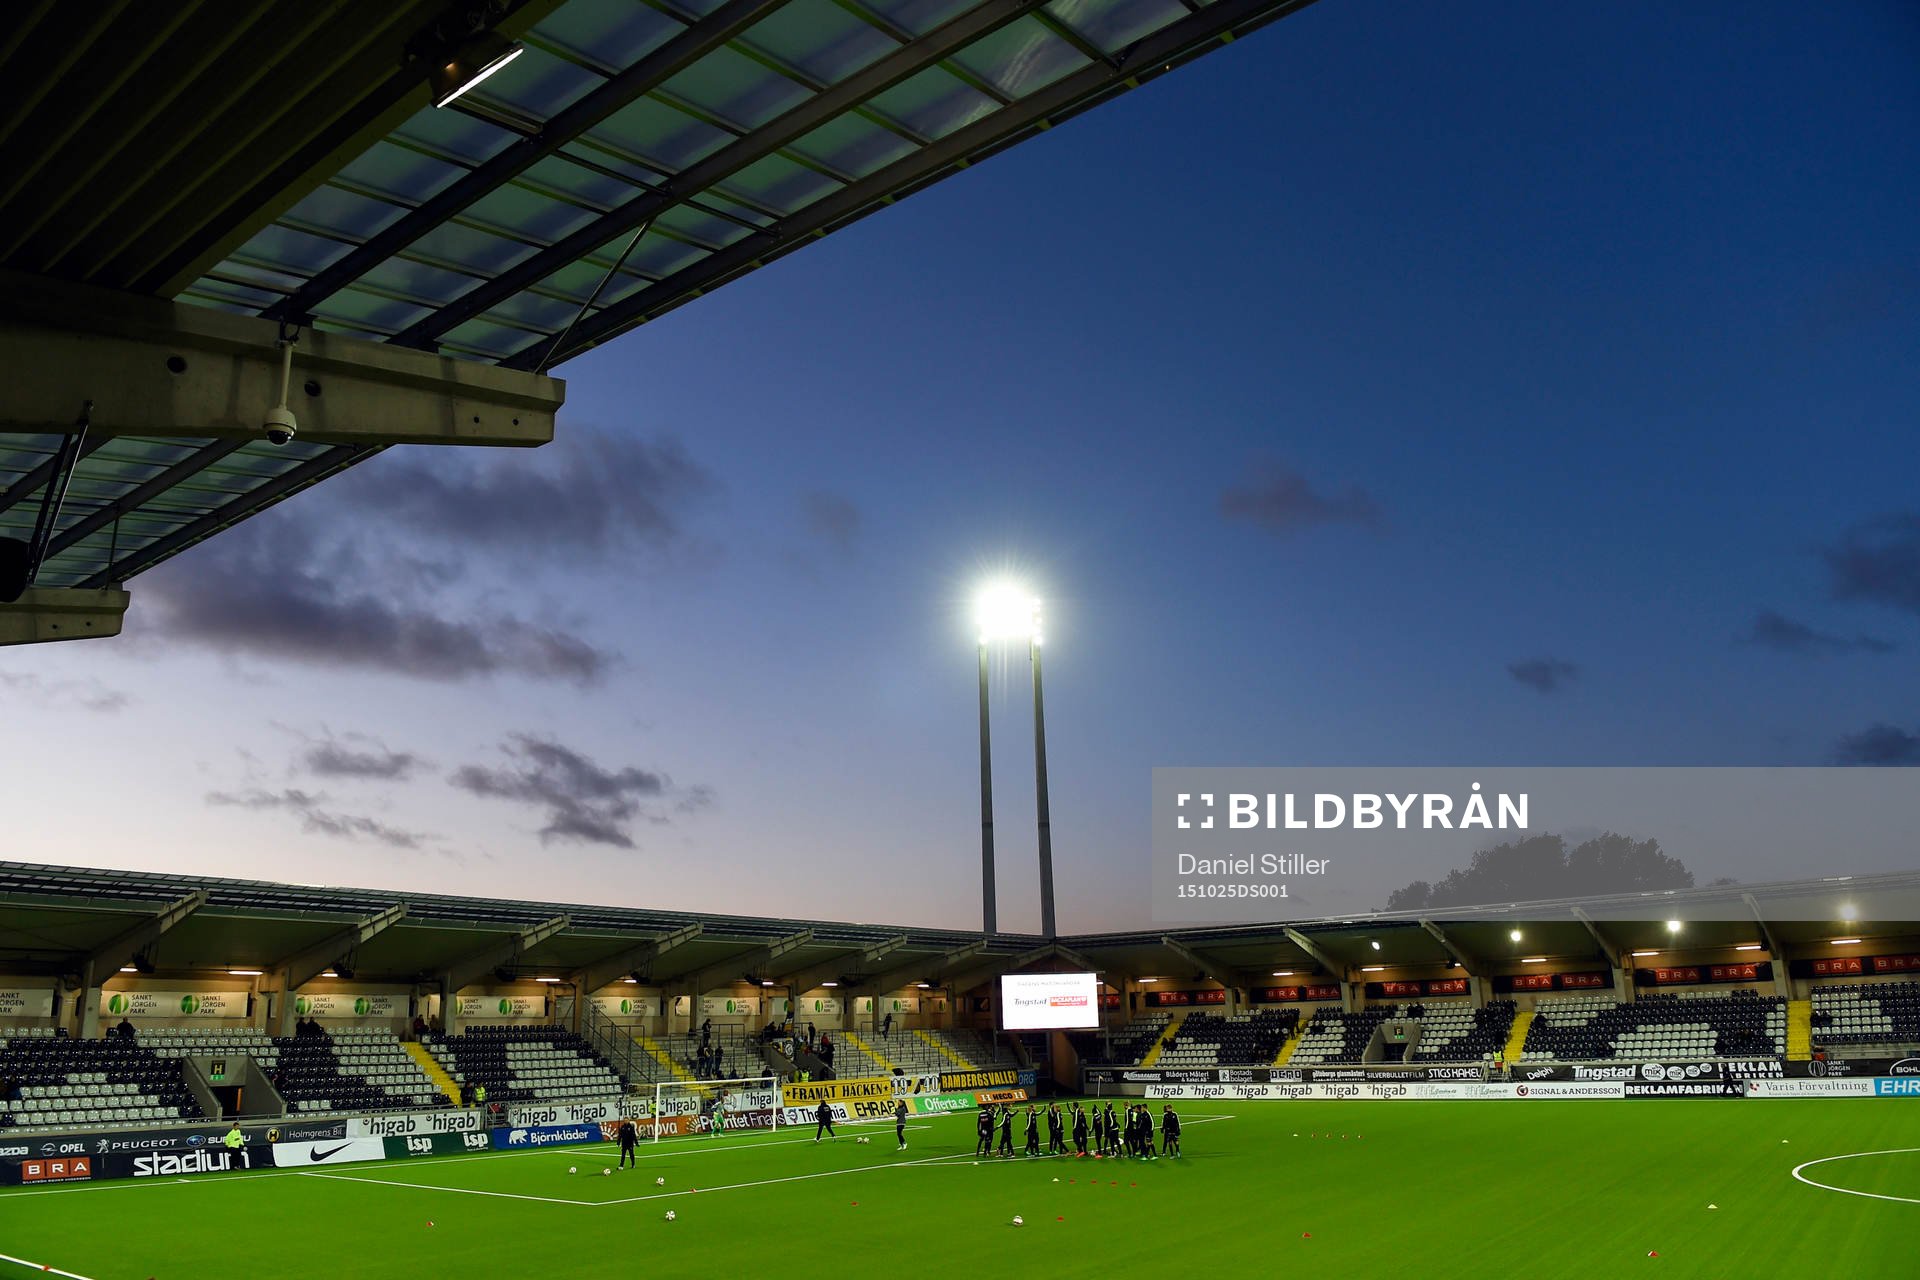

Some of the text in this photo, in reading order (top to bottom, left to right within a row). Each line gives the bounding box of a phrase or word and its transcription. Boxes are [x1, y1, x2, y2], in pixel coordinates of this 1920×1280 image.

[1817, 960, 1859, 971] BRA
[1878, 957, 1920, 967] BRA
[1660, 971, 1697, 979] BRA
[1714, 968, 1753, 976] BRA
[1515, 978, 1550, 986] BRA
[1565, 976, 1600, 984] BRA
[1309, 987, 1338, 996] BRA
[1386, 985, 1419, 993] BRA
[1432, 983, 1463, 991] BRA
[213, 1064, 223, 1074] H
[1526, 1066, 1554, 1080] Delphi
[1572, 1065, 1637, 1080] Tingstad
[1644, 1067, 1661, 1076] mix
[941, 1070, 1018, 1089] RAMBERGSVALLEN
[1230, 1075, 1253, 1083] bolaget
[843, 1083, 883, 1098] HÄCKEN
[892, 1078, 908, 1095] 19
[1154, 1085, 1183, 1098] higab
[1195, 1085, 1225, 1098] higab
[1236, 1085, 1268, 1098] higab
[1280, 1085, 1312, 1098] higab
[1325, 1085, 1359, 1098] higab
[1372, 1085, 1407, 1098] higab
[1766, 1080, 1868, 1092] Varis Förvaltning
[1880, 1080, 1920, 1094] EHR
[665, 1097, 697, 1115] higab
[854, 1100, 909, 1117] EHRAB
[925, 1097, 969, 1110] Offerta.se
[519, 1106, 557, 1128] higab
[570, 1103, 607, 1123] higab
[798, 1105, 847, 1122] Themia
[369, 1115, 416, 1137] higab
[432, 1112, 475, 1133] higab
[699, 1113, 750, 1130] Prritet
[208, 1134, 251, 1144] SUU
[289, 1128, 331, 1139] Holmgrens
[463, 1132, 489, 1147] isp
[530, 1129, 589, 1145] Björnkläder
[60, 1143, 86, 1153] OPEL
[112, 1138, 177, 1150] PEUGEOT
[406, 1136, 433, 1152] isp
[28, 1162, 87, 1175] BRA
[134, 1149, 250, 1177] stadium
